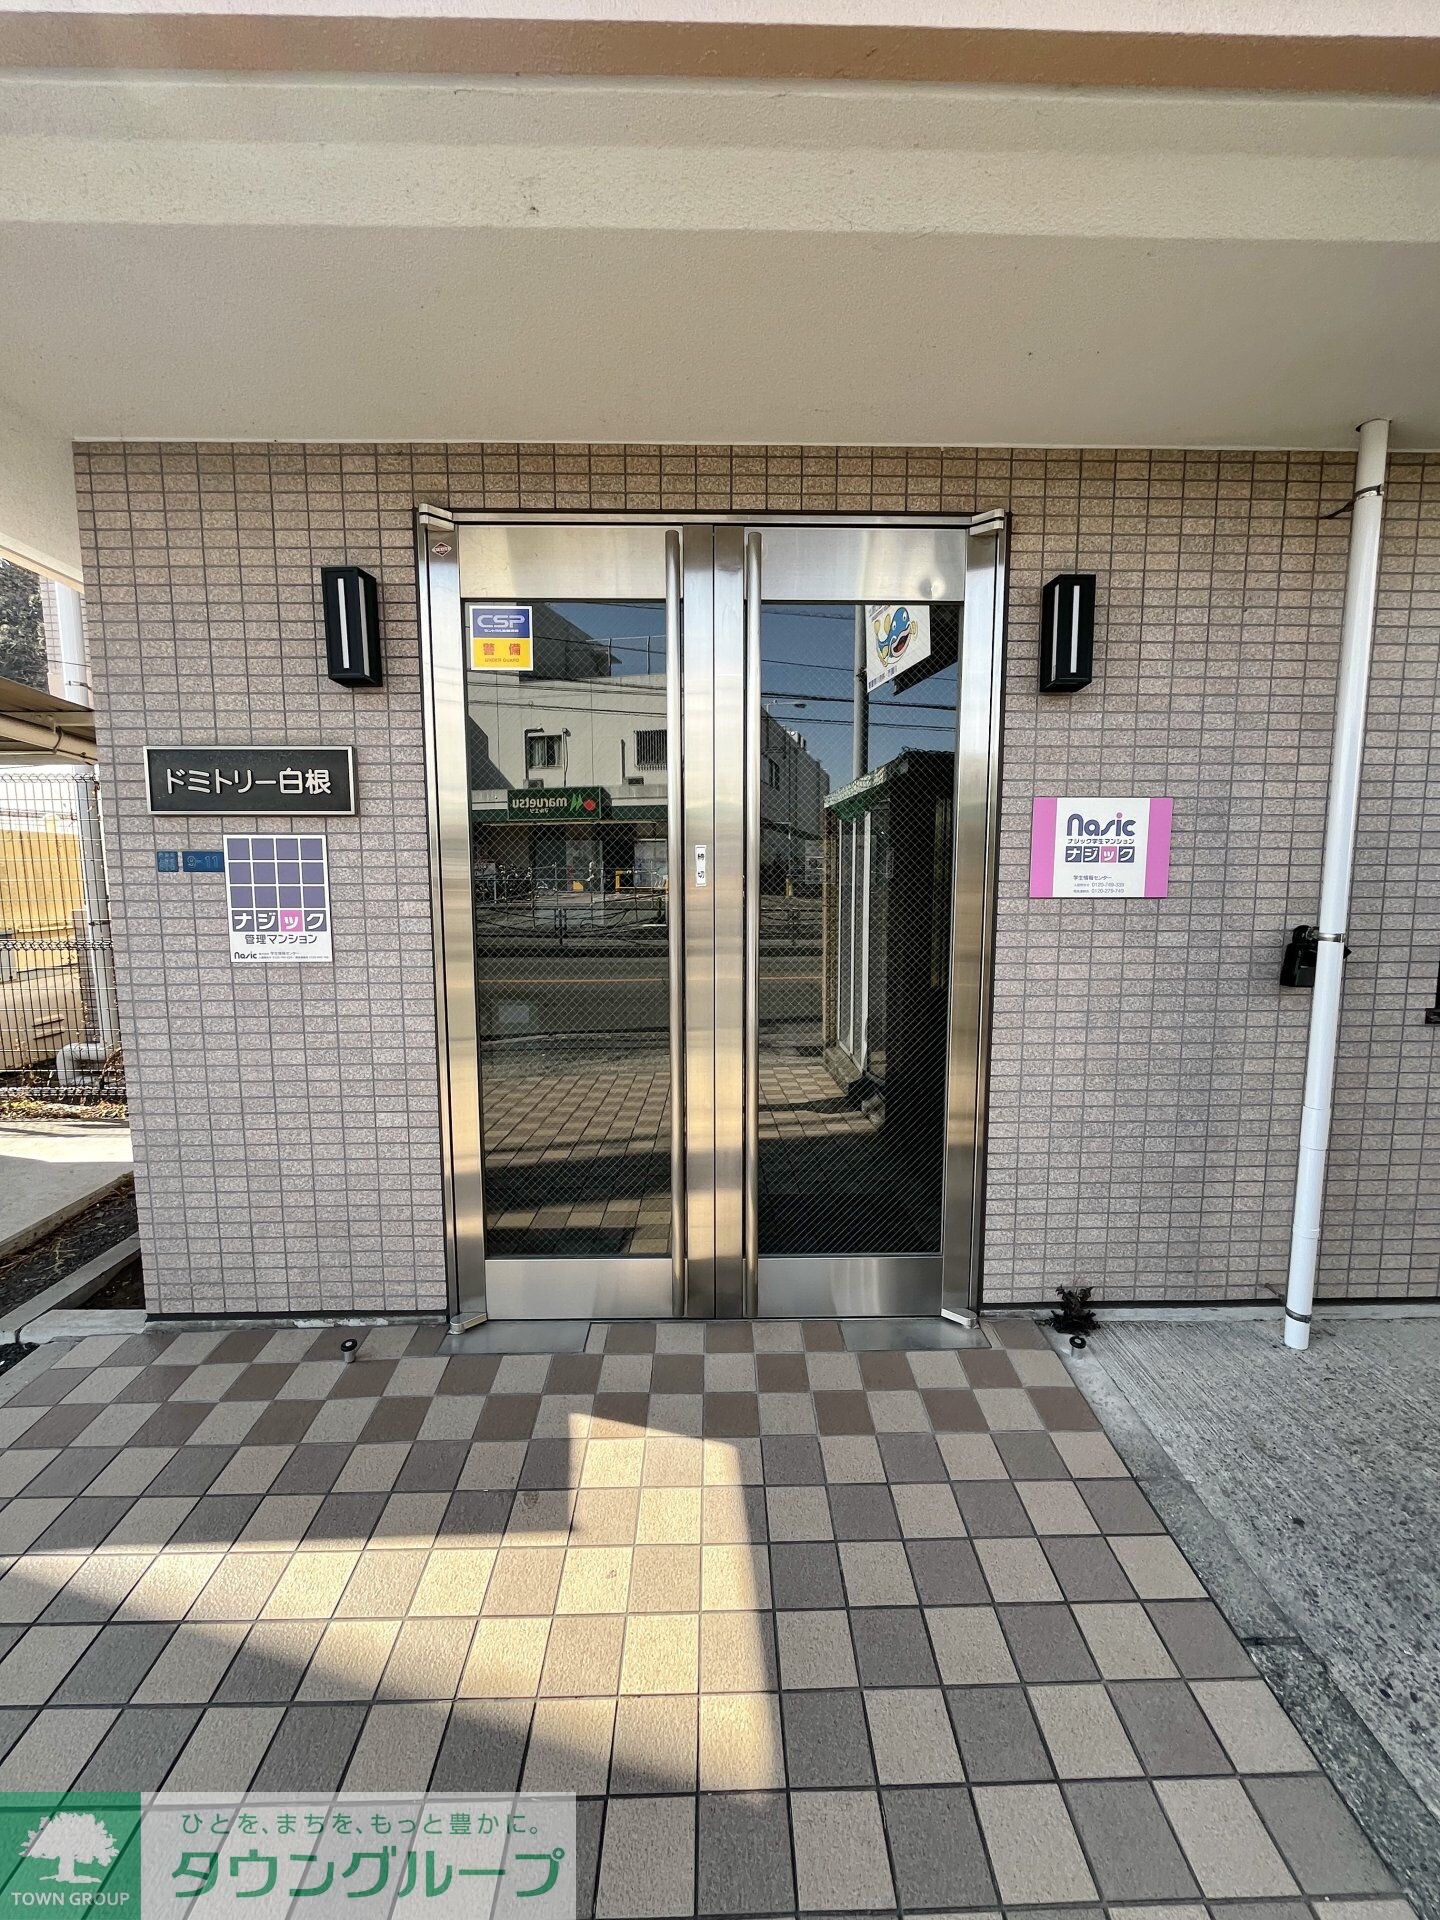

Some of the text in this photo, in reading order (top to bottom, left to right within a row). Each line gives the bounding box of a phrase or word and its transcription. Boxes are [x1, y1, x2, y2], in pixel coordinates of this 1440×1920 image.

[477, 615, 525, 628] CSP
[166, 768, 332, 795] ドミトリー白根
[1066, 846, 1134, 862] ナジック
[233, 912, 326, 931] ナジック
[244, 934, 318, 945] 管理マンション
